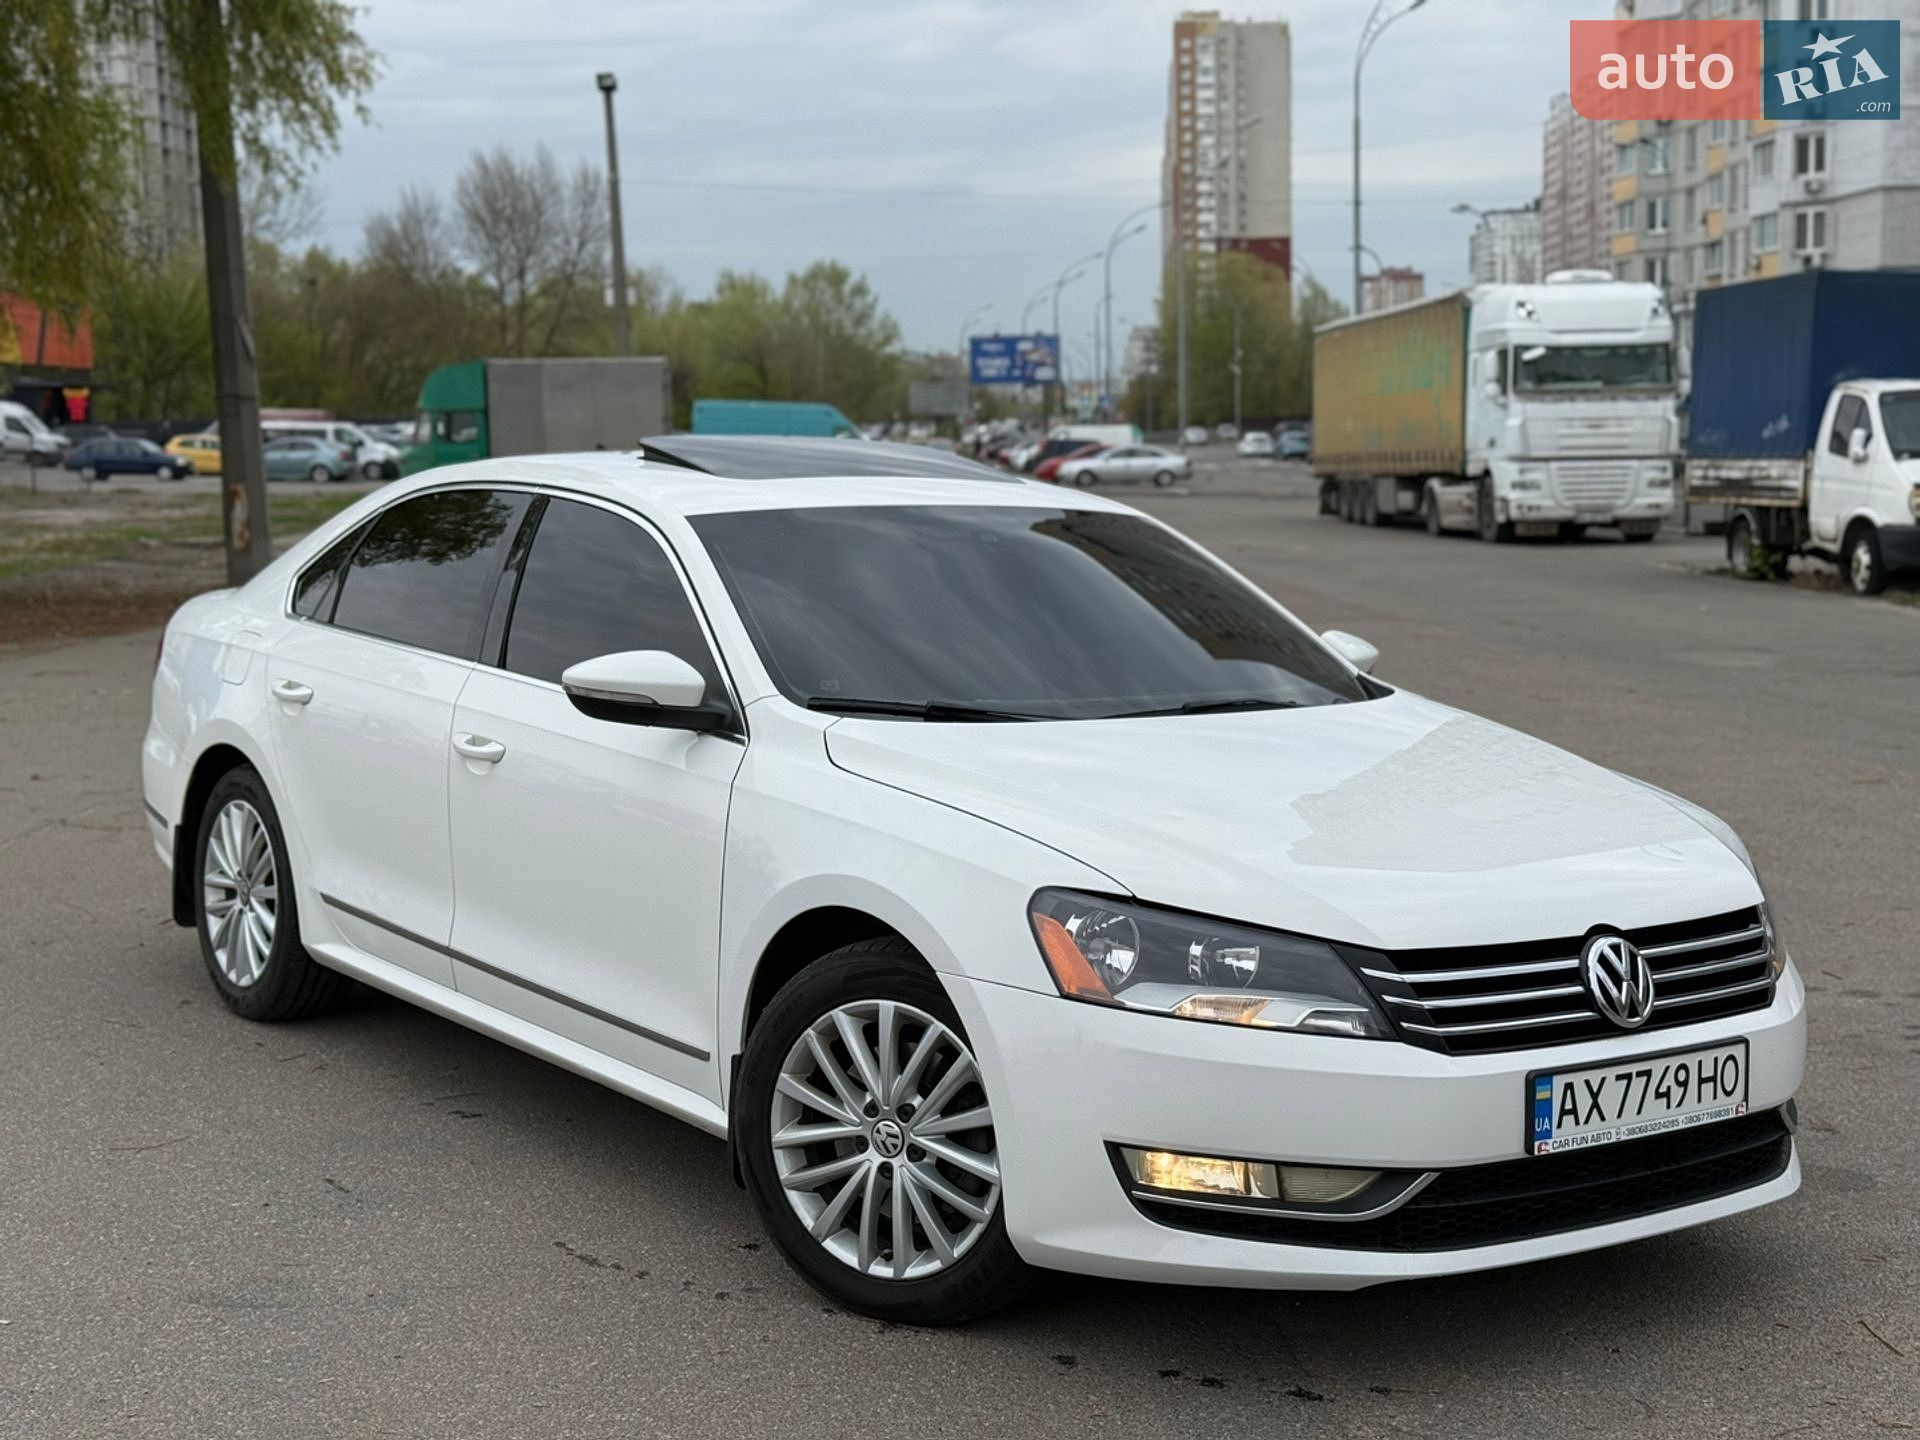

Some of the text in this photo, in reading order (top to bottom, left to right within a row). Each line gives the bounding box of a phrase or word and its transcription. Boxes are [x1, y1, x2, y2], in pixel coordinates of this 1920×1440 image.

[1556, 1053, 1740, 1129] AX 7749 HO
[1535, 1117, 1551, 1132] UA
[1552, 1138, 1571, 1151] CAR
[1571, 1135, 1589, 1148] FUN
